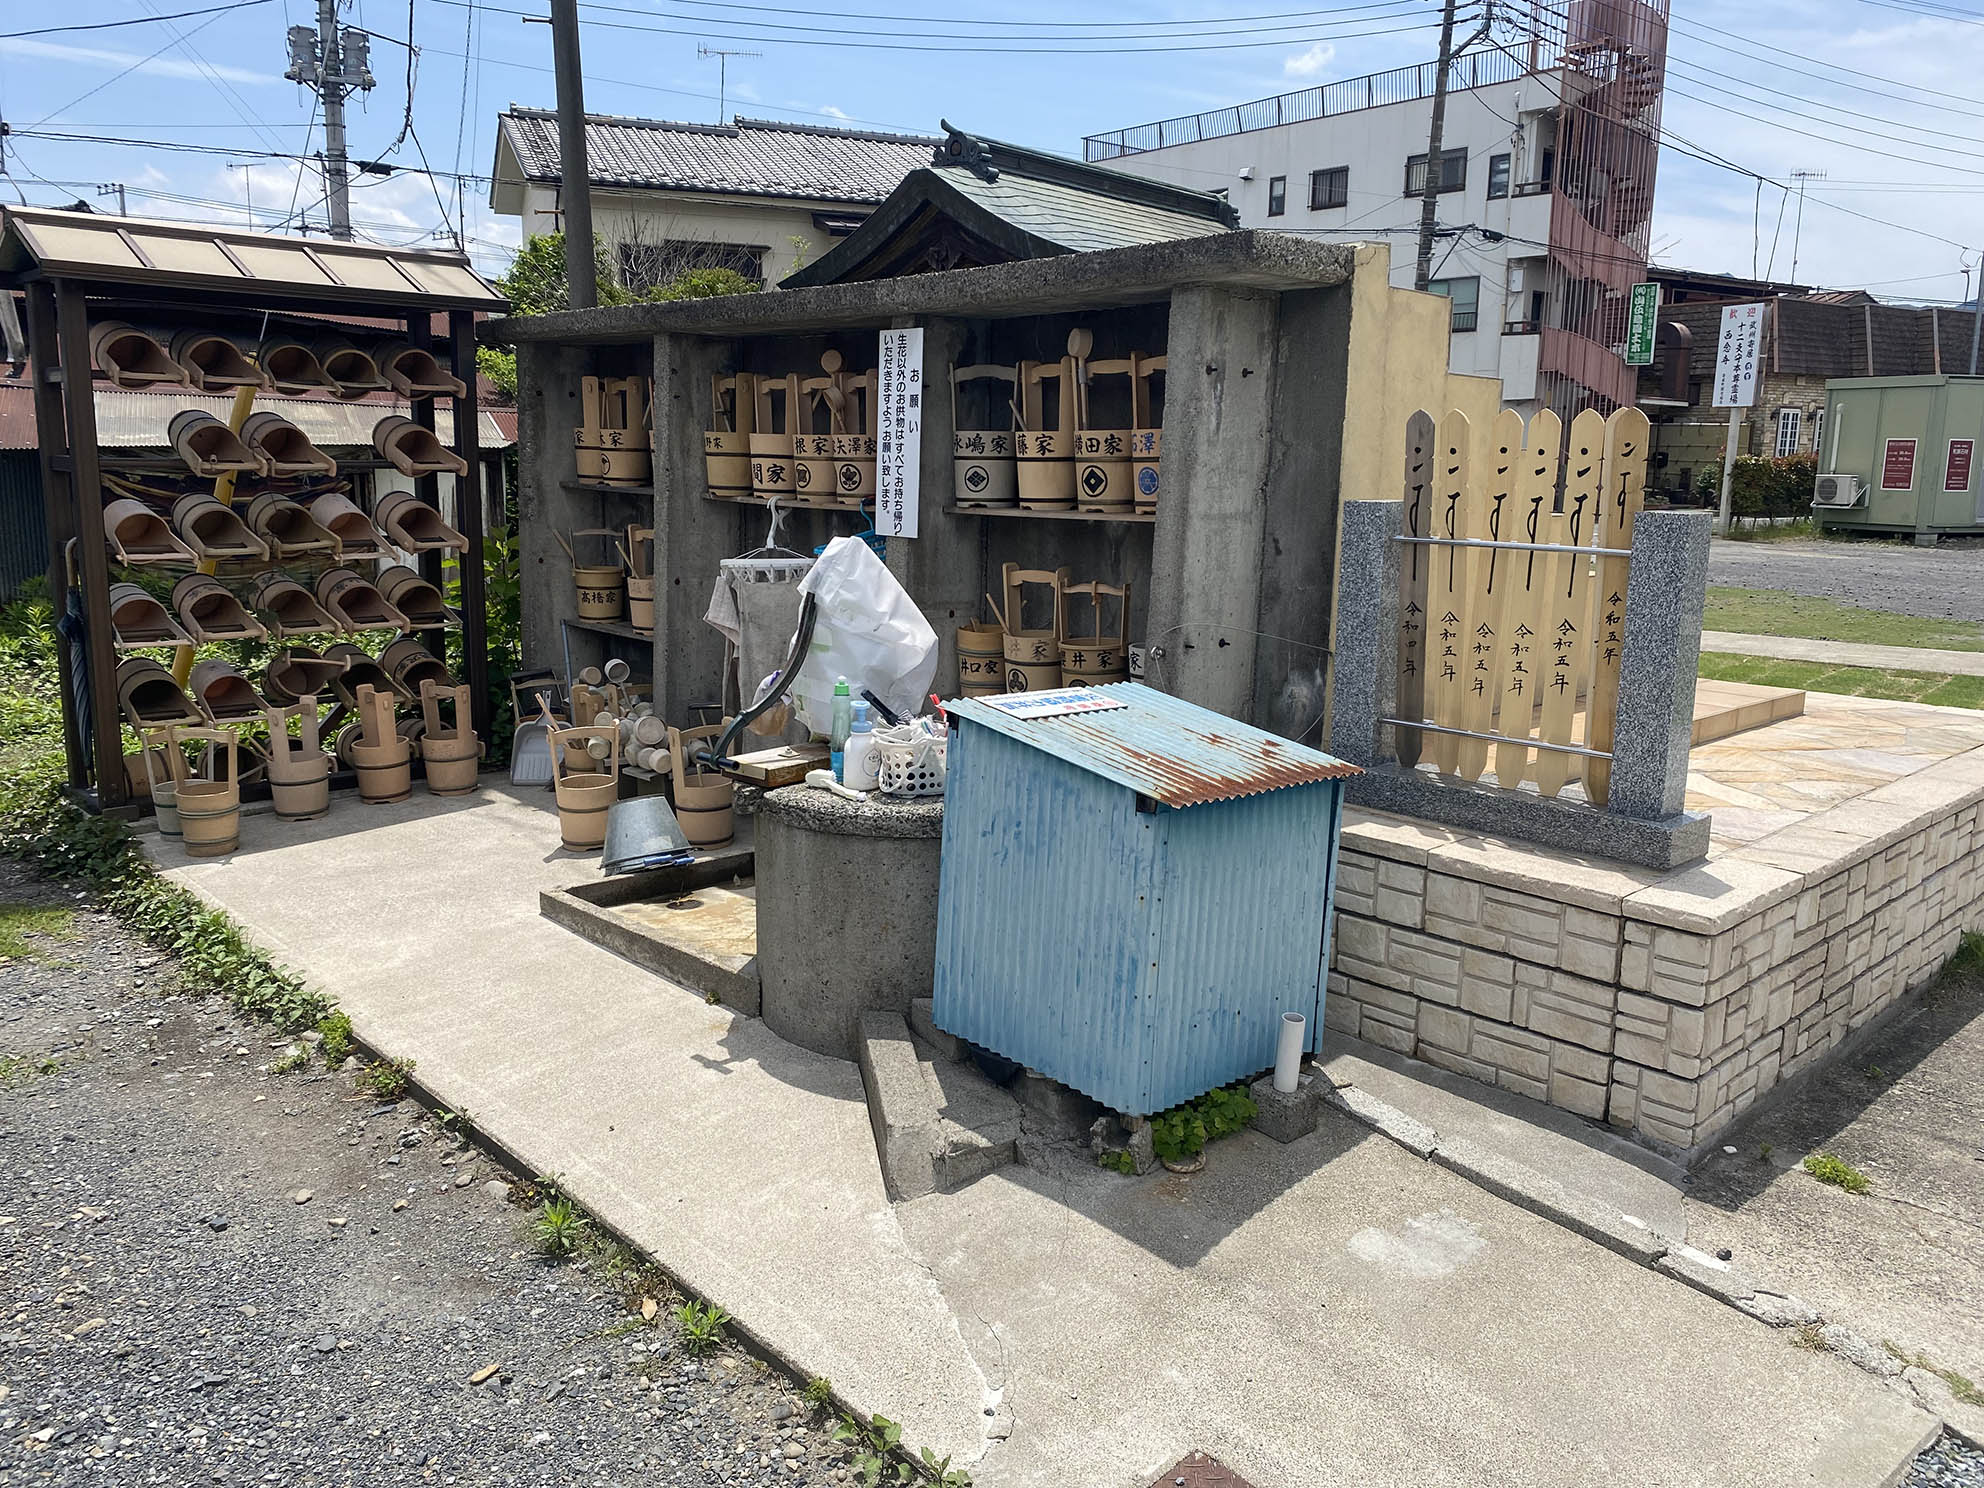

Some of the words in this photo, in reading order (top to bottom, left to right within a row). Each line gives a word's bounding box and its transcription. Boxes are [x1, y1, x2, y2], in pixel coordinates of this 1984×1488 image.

[881, 334, 894, 514] いただきますようお願い致します。
[893, 333, 907, 536] 生花以外のお供物はすべてお持ち帰り
[909, 368, 920, 433] お願い
[1440, 610, 1460, 683] 令和五年
[1471, 621, 1495, 697] 令和五年
[1507, 622, 1535, 697] 令和五年
[1550, 618, 1577, 696] 令和五年
[1603, 591, 1623, 665] 令和五年
